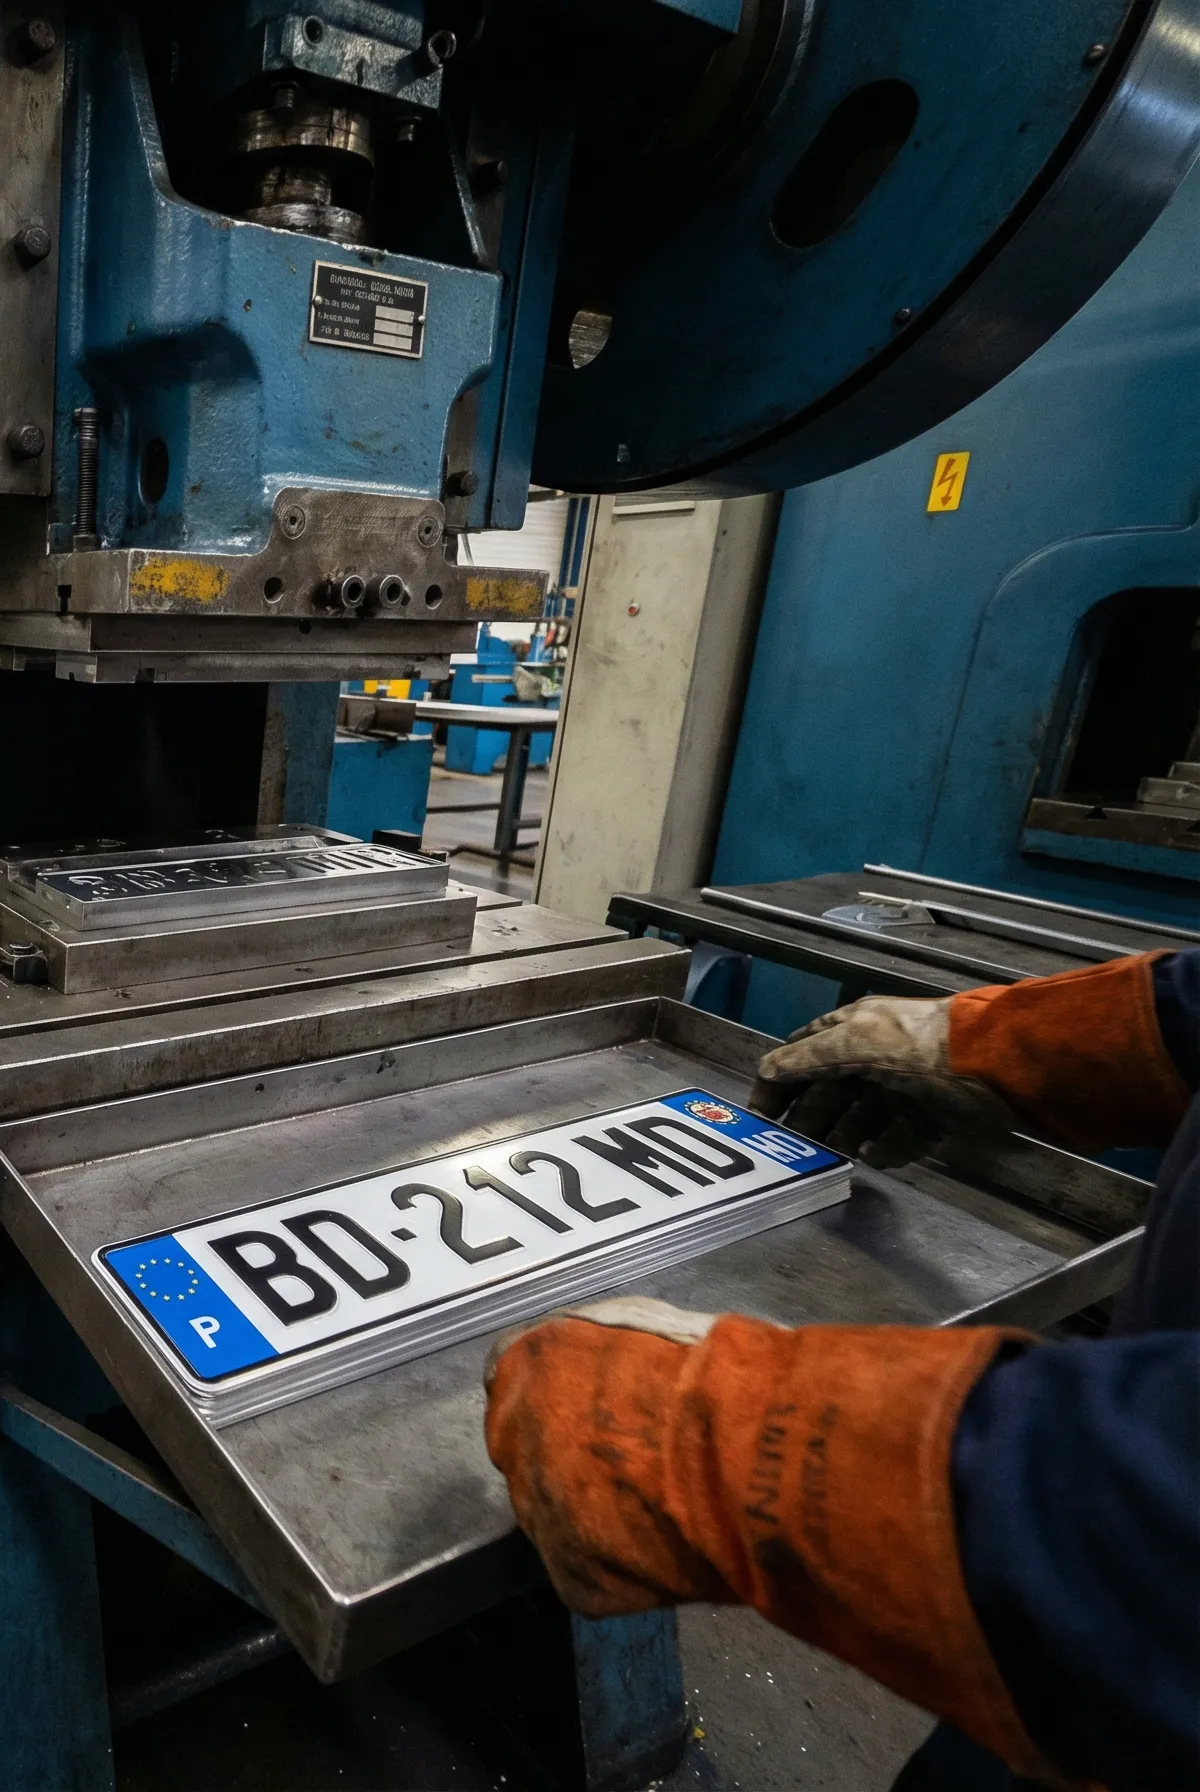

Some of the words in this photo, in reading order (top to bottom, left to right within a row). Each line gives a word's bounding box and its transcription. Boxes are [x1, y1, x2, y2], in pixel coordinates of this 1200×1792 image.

[741, 1130, 818, 1163] MD
[207, 1151, 641, 1327] BD-212
[572, 1116, 756, 1198] MD
[189, 1315, 220, 1349] P
